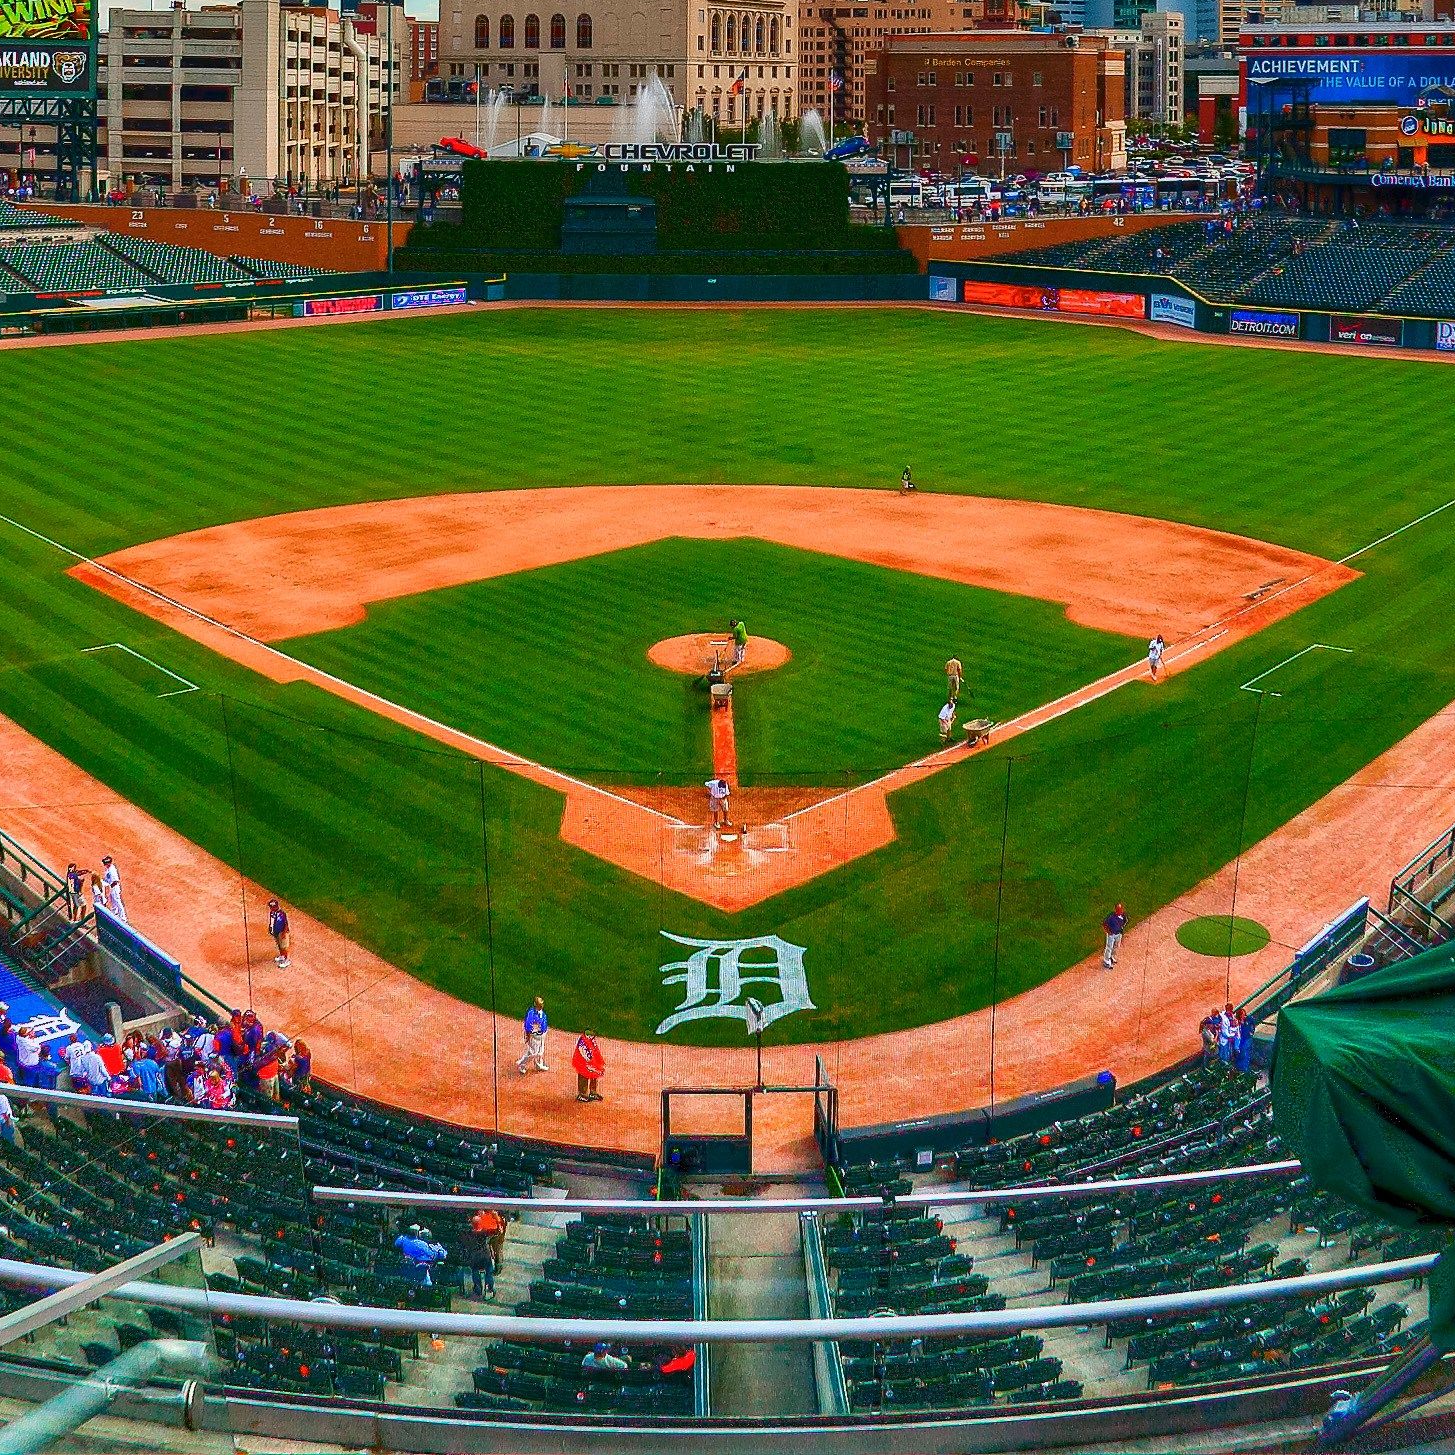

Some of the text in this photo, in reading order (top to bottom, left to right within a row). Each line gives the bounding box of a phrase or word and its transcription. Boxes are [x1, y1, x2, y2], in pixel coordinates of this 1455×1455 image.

[1319, 76, 1343, 88] THE
[1345, 76, 1384, 88] VALUE
[1388, 76, 1404, 88] OF
[1407, 76, 1417, 88] A
[602, 143, 762, 161] CHEVROLET
[576, 163, 736, 173] FOUNTAIN
[269, 217, 276, 227] 2
[314, 220, 323, 230] 16
[1112, 217, 1125, 227] 42
[363, 224, 370, 234] 6
[1230, 319, 1296, 336] DETROIT.COM
